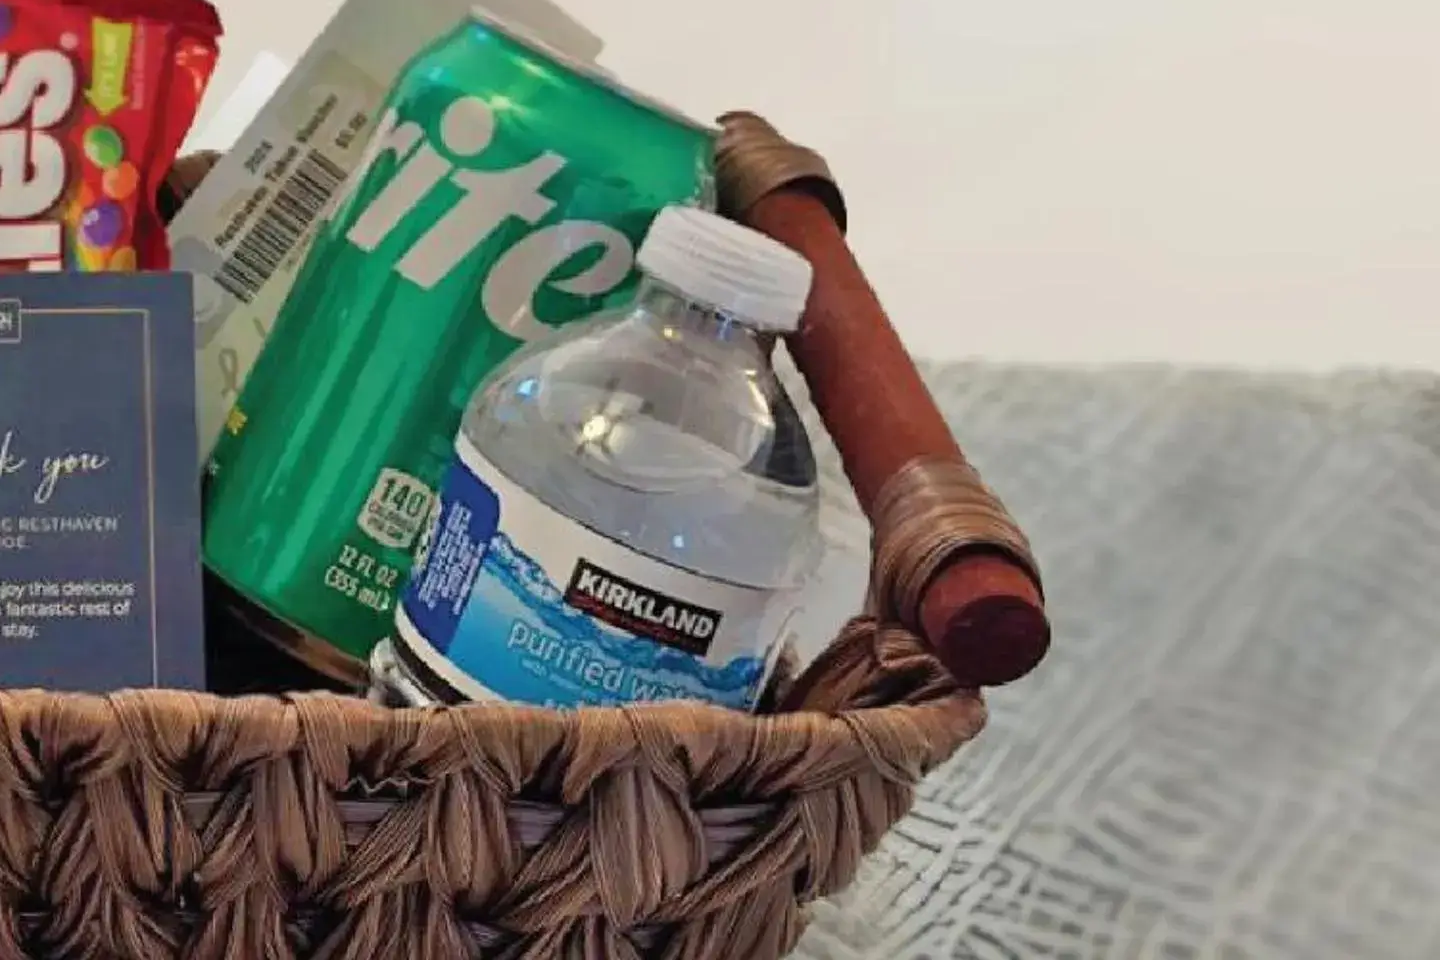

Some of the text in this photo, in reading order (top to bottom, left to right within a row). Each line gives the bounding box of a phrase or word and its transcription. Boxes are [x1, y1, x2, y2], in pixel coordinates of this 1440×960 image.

[325, 96, 634, 343] rite
[33, 452, 110, 504] you
[380, 478, 427, 517] 140
[18, 514, 118, 534] RESTHAVEN
[5, 599, 76, 617] fantastic
[79, 599, 110, 616] rest
[112, 598, 131, 616] of
[28, 581, 59, 596] this
[61, 580, 136, 596] delicious
[577, 568, 714, 638] KIRKLAND
[509, 616, 626, 691] purified
